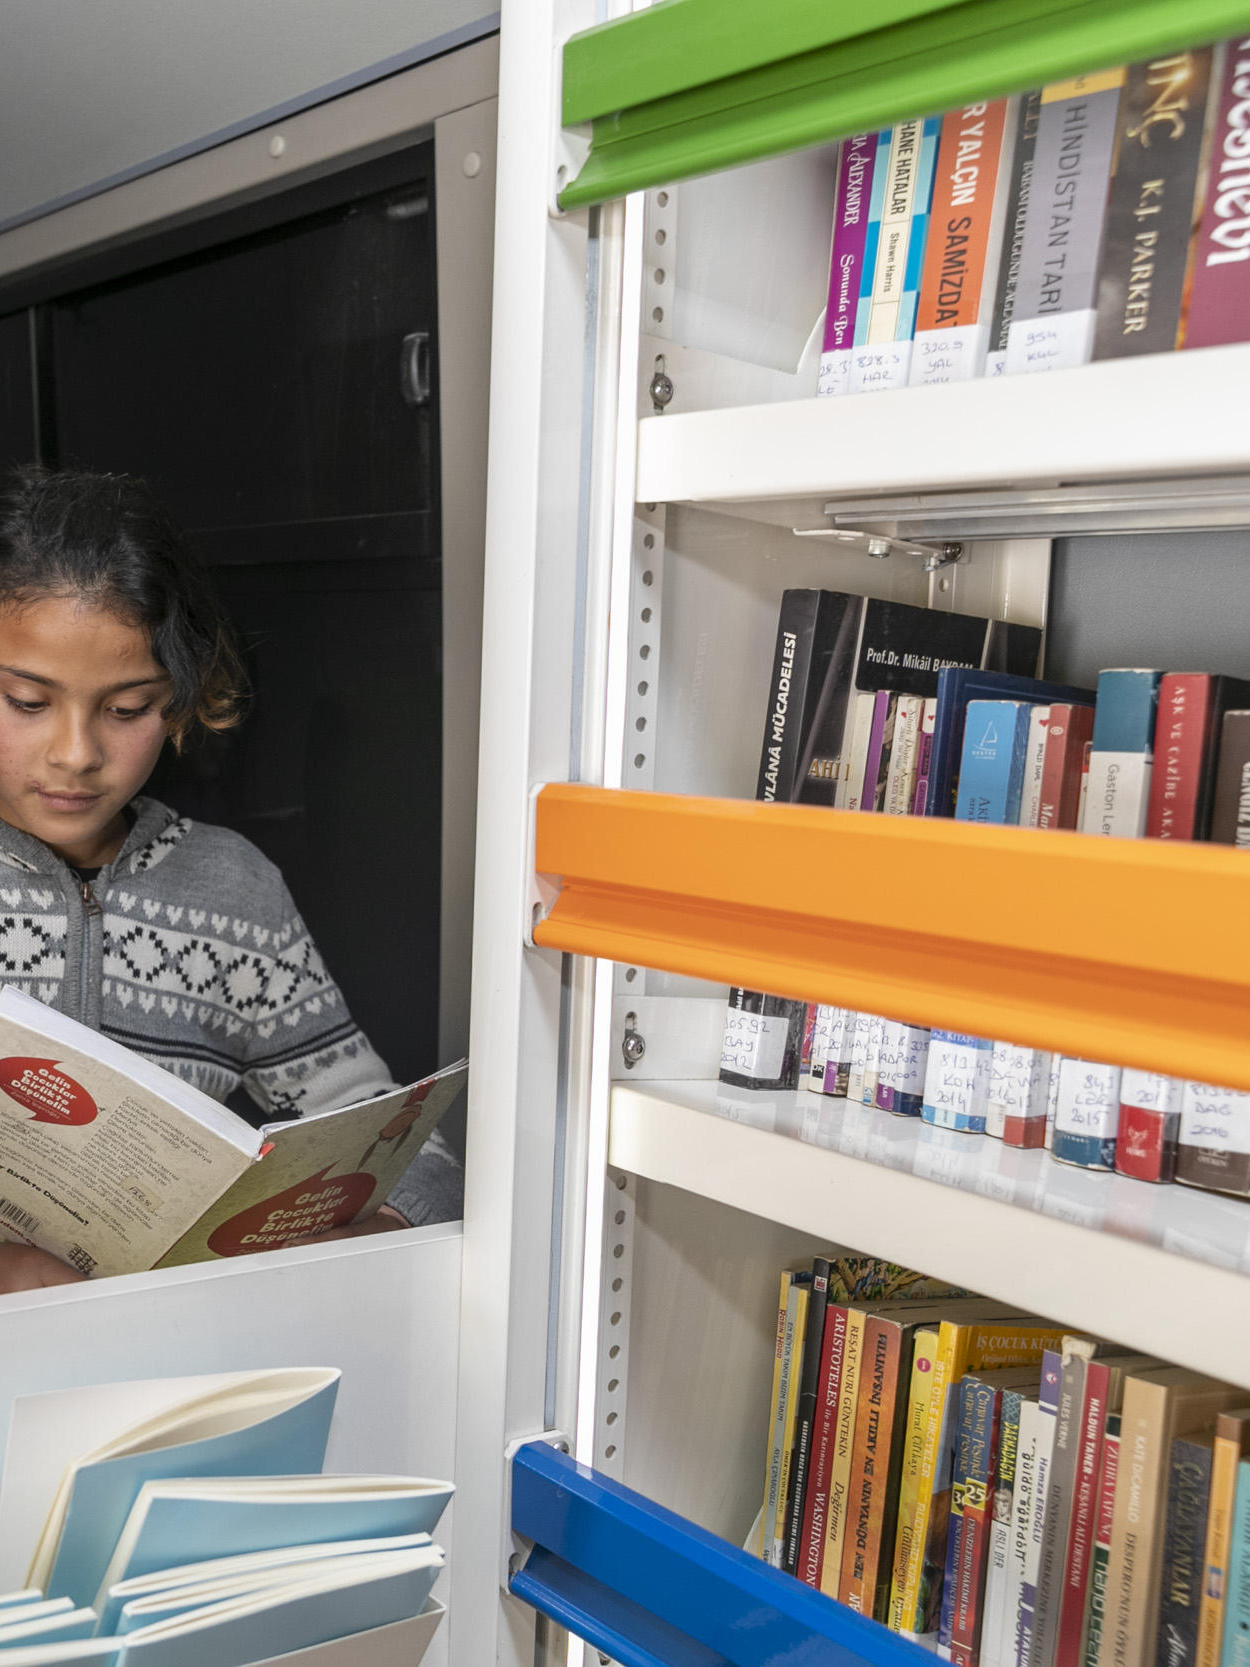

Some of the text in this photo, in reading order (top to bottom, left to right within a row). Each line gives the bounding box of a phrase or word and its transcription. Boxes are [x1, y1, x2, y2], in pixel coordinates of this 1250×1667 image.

[950, 121, 986, 207] YALÇIN
[1049, 103, 1088, 248] HİNDİSTAN
[843, 152, 871, 228] ALEXANDER
[890, 158, 912, 215] HATALAR
[883, 232, 900, 293] Shawn Harris
[1124, 178, 1166, 335] K.J. PARKER
[833, 254, 855, 345] Sonunda Ben
[866, 647, 932, 672] Prof.Dr. Mikâil
[772, 632, 798, 742] MÜCADELESİ
[1171, 686, 1186, 715] AŞK
[1170, 722, 1183, 739] VE
[1103, 764, 1120, 811] Gaston
[10, 1079, 70, 1115] Düşünelim
[20, 1077, 69, 1106] Birlikte
[23, 1069, 77, 1100] Çocuklar
[38, 1068, 71, 1089] Gelin
[5, 1167, 43, 1192] Birlikte
[41, 1189, 91, 1225] Düşünelim?
[267, 1194, 349, 1223] Çocuklar
[294, 1186, 343, 1205] Gelin
[258, 1212, 335, 1233] Birlikte
[776, 1308, 787, 1359] ROBIN HOOD
[976, 1332, 1030, 1352] İŞ ÇOCUK
[826, 1312, 846, 1408] ARİSTOTELES
[913, 1401, 925, 1432] Murat
[973, 1390, 990, 1438] Canavar
[1060, 1393, 1072, 1420] JULES
[1086, 1397, 1100, 1440] HALDUN
[830, 1325, 859, 1542] REŞAT NURİ GÜNTEKİN Değirmen
[1057, 1420, 1069, 1450] VERNE
[1133, 1434, 1146, 1463] KATE
[853, 1332, 888, 1581] BEN DÜNYANIN EN AKILLI İNSANIYIM
[1082, 1441, 1096, 1475] TANER
[966, 1484, 985, 1500] 25
[993, 1420, 1019, 1569] DARMADAĞIN ASLI DER
[1032, 1457, 1048, 1544] Hamza EROĞLU
[958, 1603, 968, 1631] KRABB
